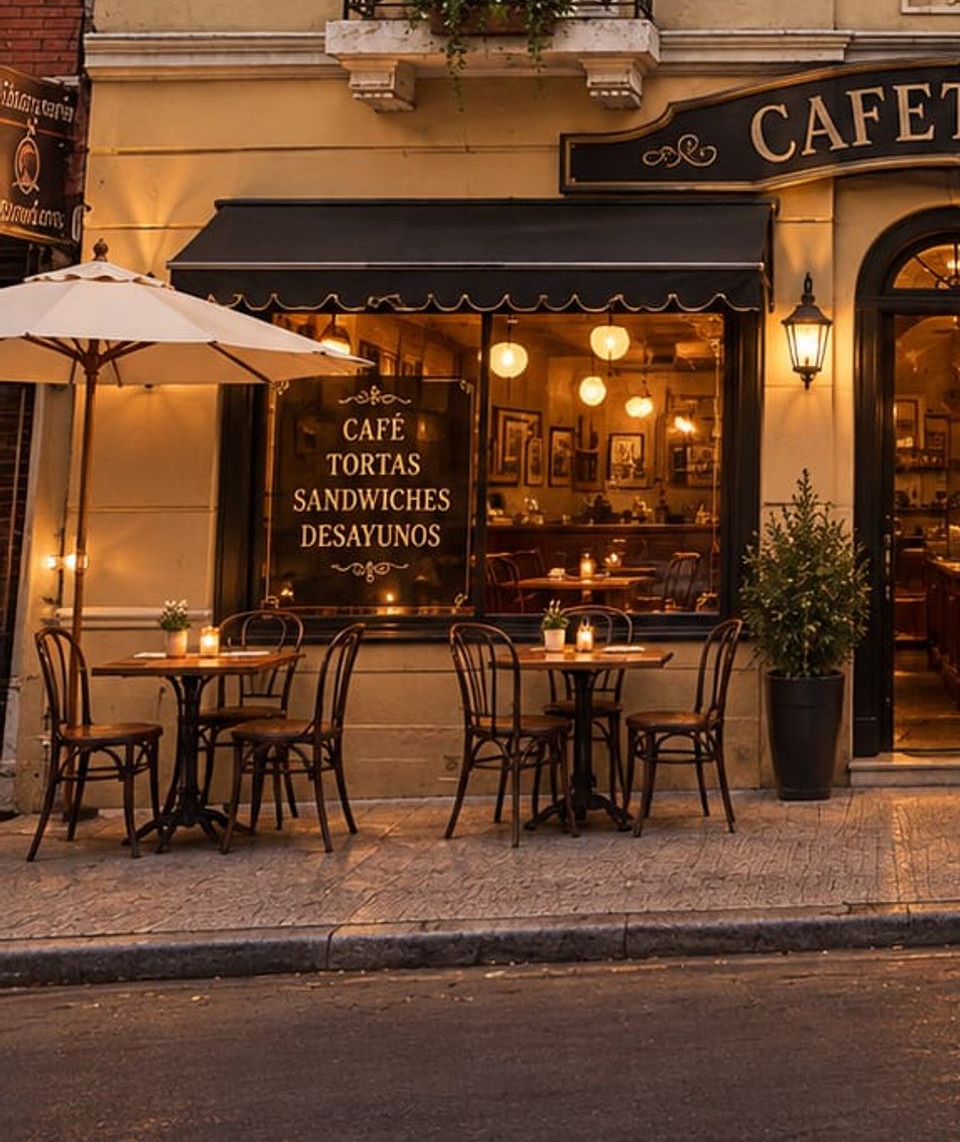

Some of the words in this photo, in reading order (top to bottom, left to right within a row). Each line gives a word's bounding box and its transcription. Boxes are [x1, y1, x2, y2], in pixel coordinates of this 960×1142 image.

[342, 412, 406, 442] CAFÉ
[326, 452, 421, 476] TORTAS
[293, 488, 451, 512] SANDWICHES
[300, 523, 441, 548] DESAYUNOS
